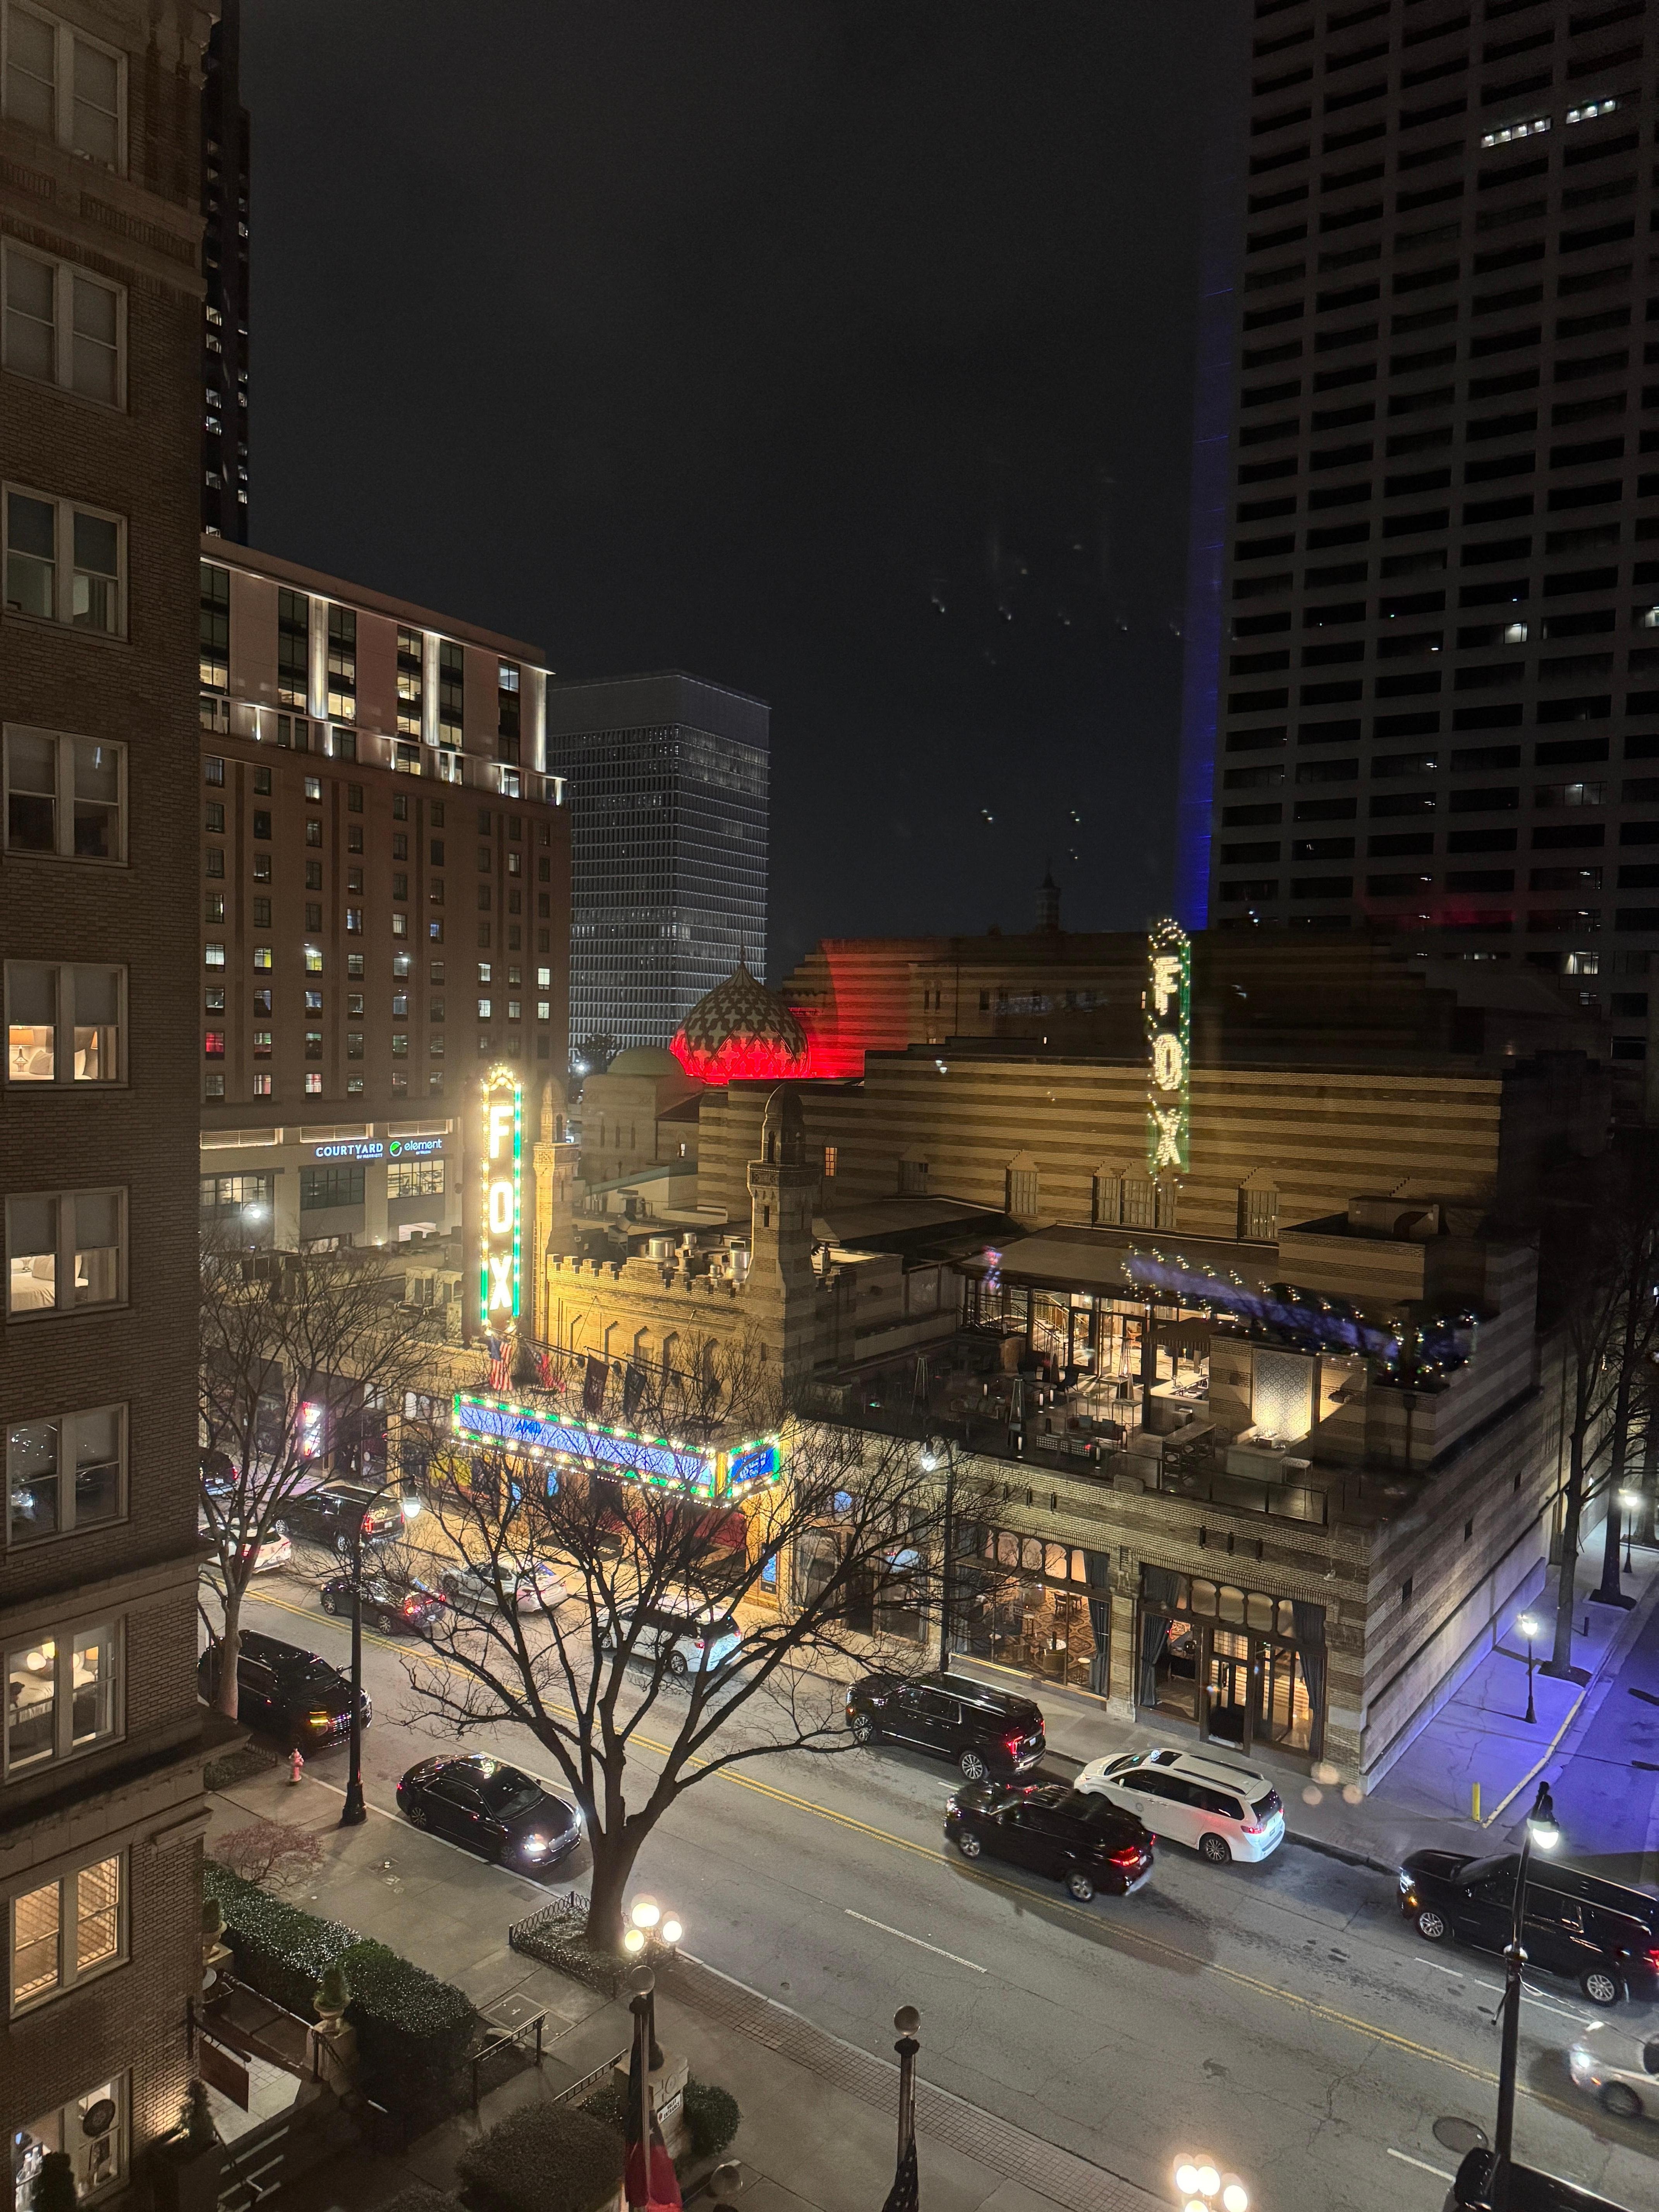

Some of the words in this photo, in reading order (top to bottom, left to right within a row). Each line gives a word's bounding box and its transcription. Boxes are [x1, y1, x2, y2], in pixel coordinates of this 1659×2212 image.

[316, 1143, 383, 1157] COURTYARD
[404, 1139, 442, 1151] element
[489, 1104, 515, 1311] FOX
